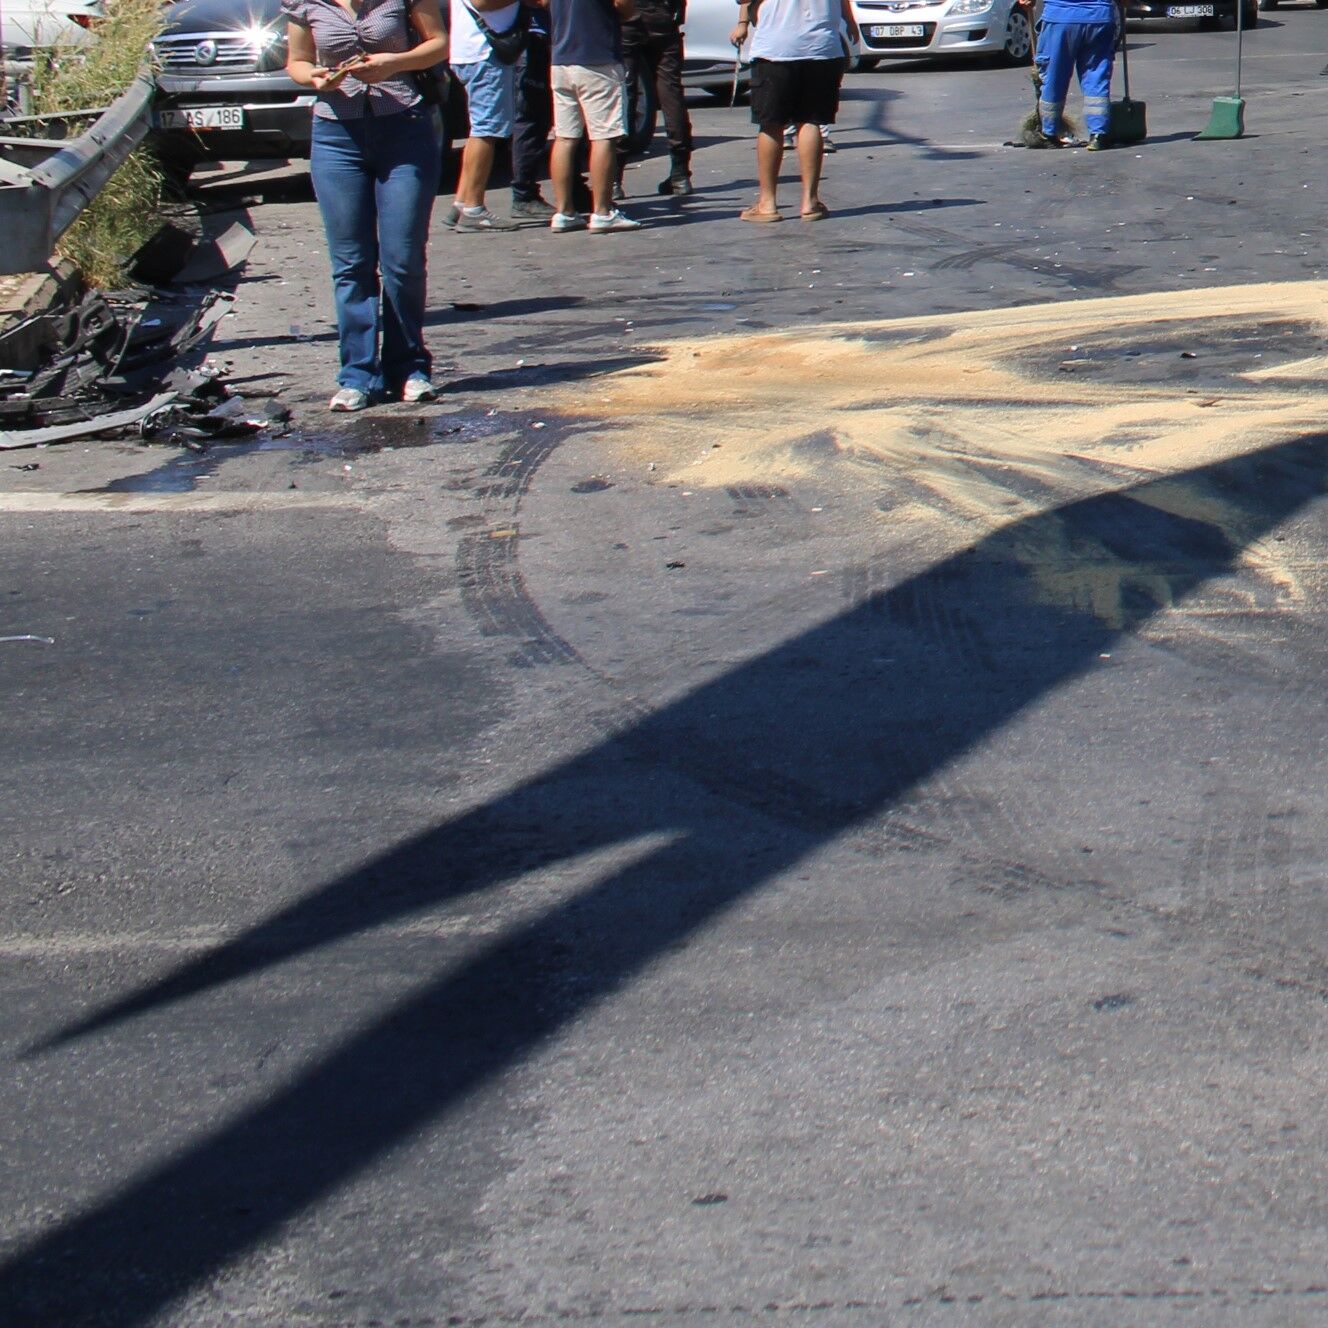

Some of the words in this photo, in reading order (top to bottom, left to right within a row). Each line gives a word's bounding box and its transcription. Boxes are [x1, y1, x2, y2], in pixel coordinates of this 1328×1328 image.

[161, 111, 175, 127] 17
[186, 111, 203, 126] AS
[216, 109, 240, 124] 186
